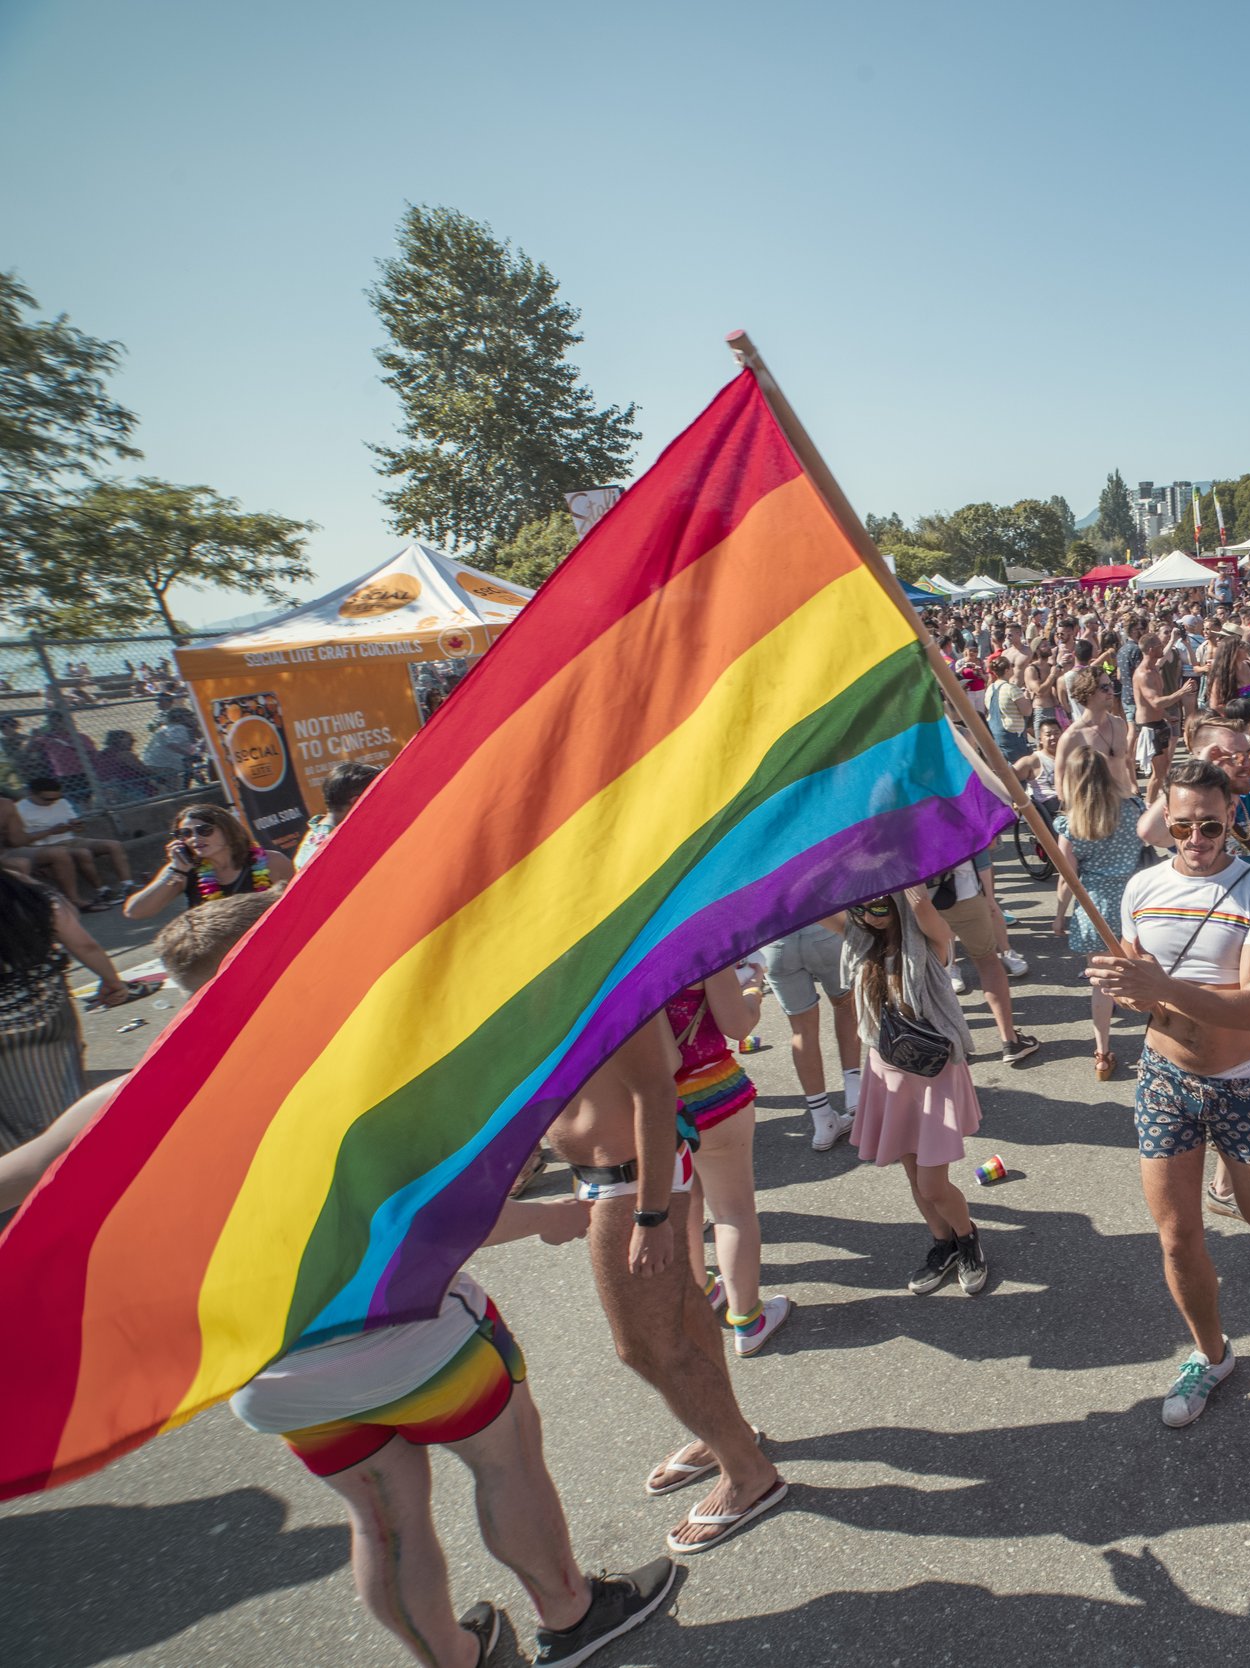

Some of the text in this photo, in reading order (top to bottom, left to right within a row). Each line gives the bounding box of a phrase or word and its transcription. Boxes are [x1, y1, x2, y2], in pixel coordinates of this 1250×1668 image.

[289, 649, 316, 665] LITE
[318, 643, 357, 661] CRAFT
[360, 639, 424, 658] COCKTAILS
[293, 711, 366, 739] NOTHING
[297, 727, 397, 760] TO CONFESS.
